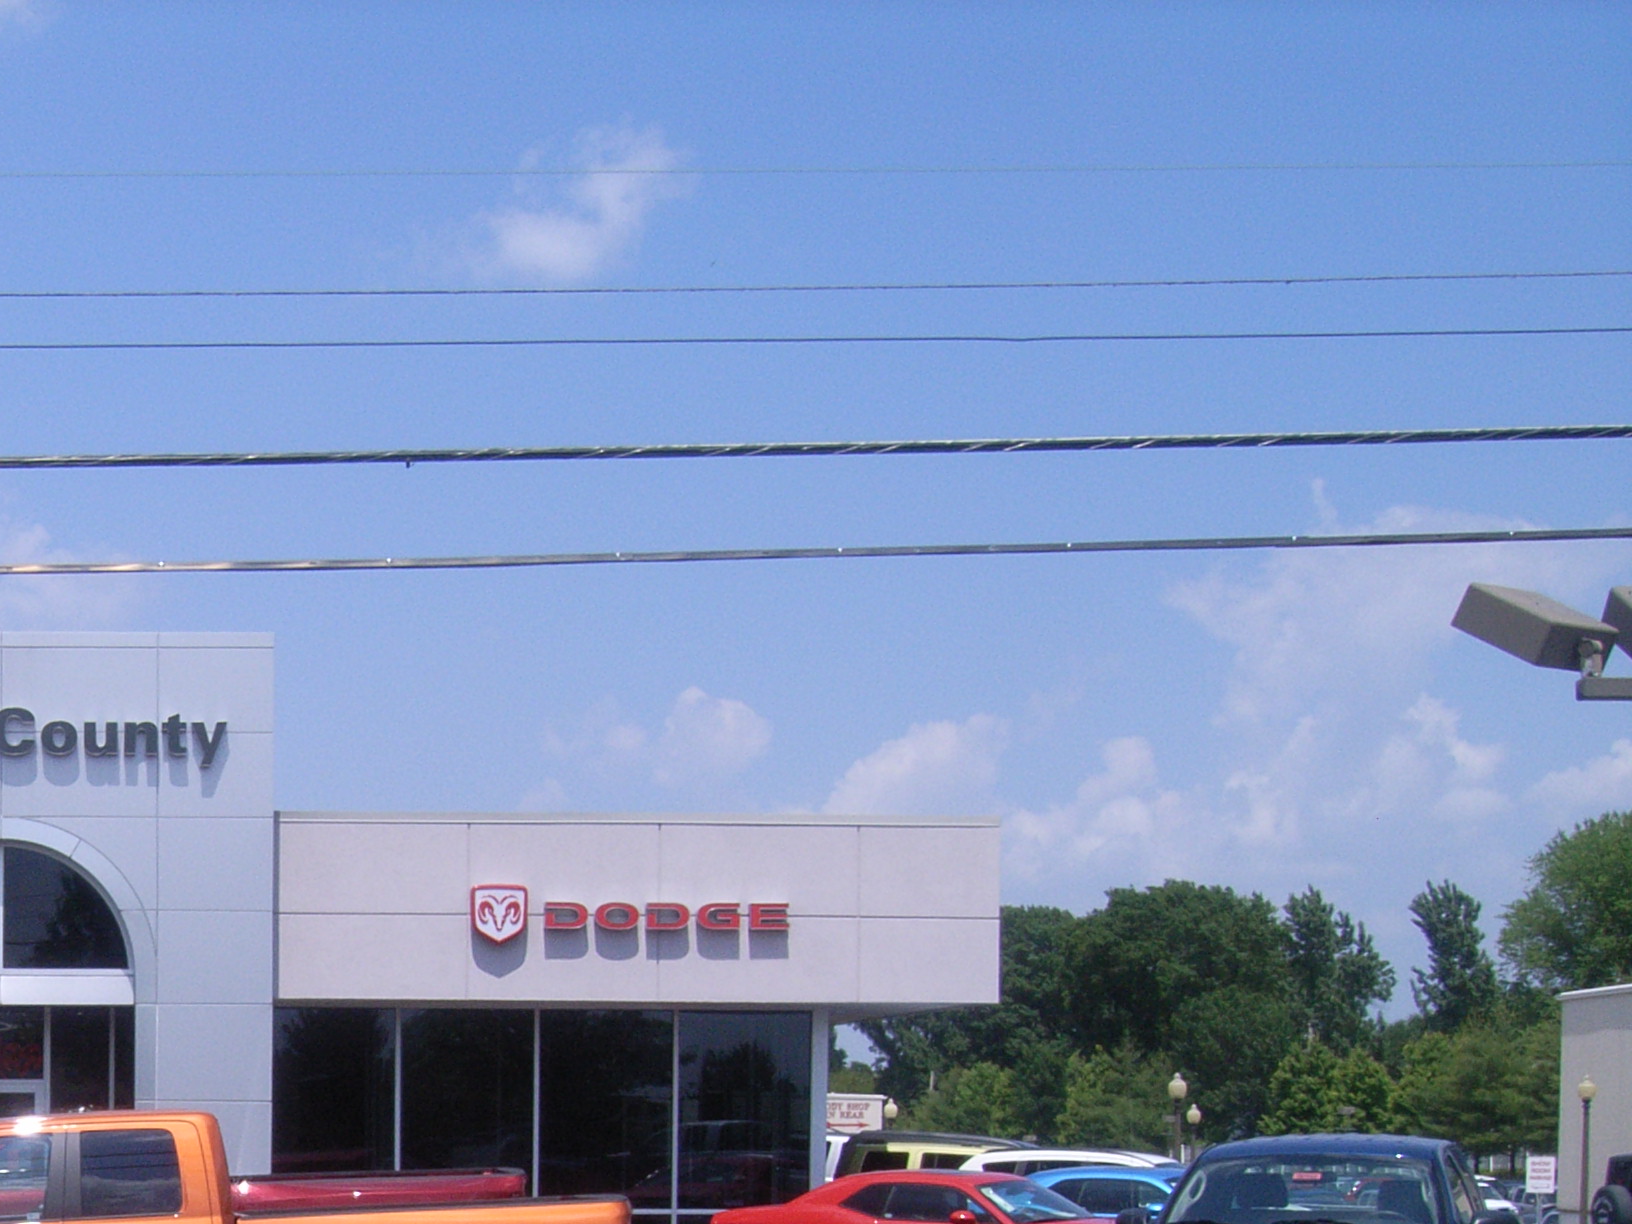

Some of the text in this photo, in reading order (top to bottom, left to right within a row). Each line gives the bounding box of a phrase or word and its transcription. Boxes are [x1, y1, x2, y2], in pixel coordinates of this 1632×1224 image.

[543, 902, 790, 931] DODGE
[846, 1102, 871, 1111] SHOP
[839, 1111, 865, 1120] REAR
